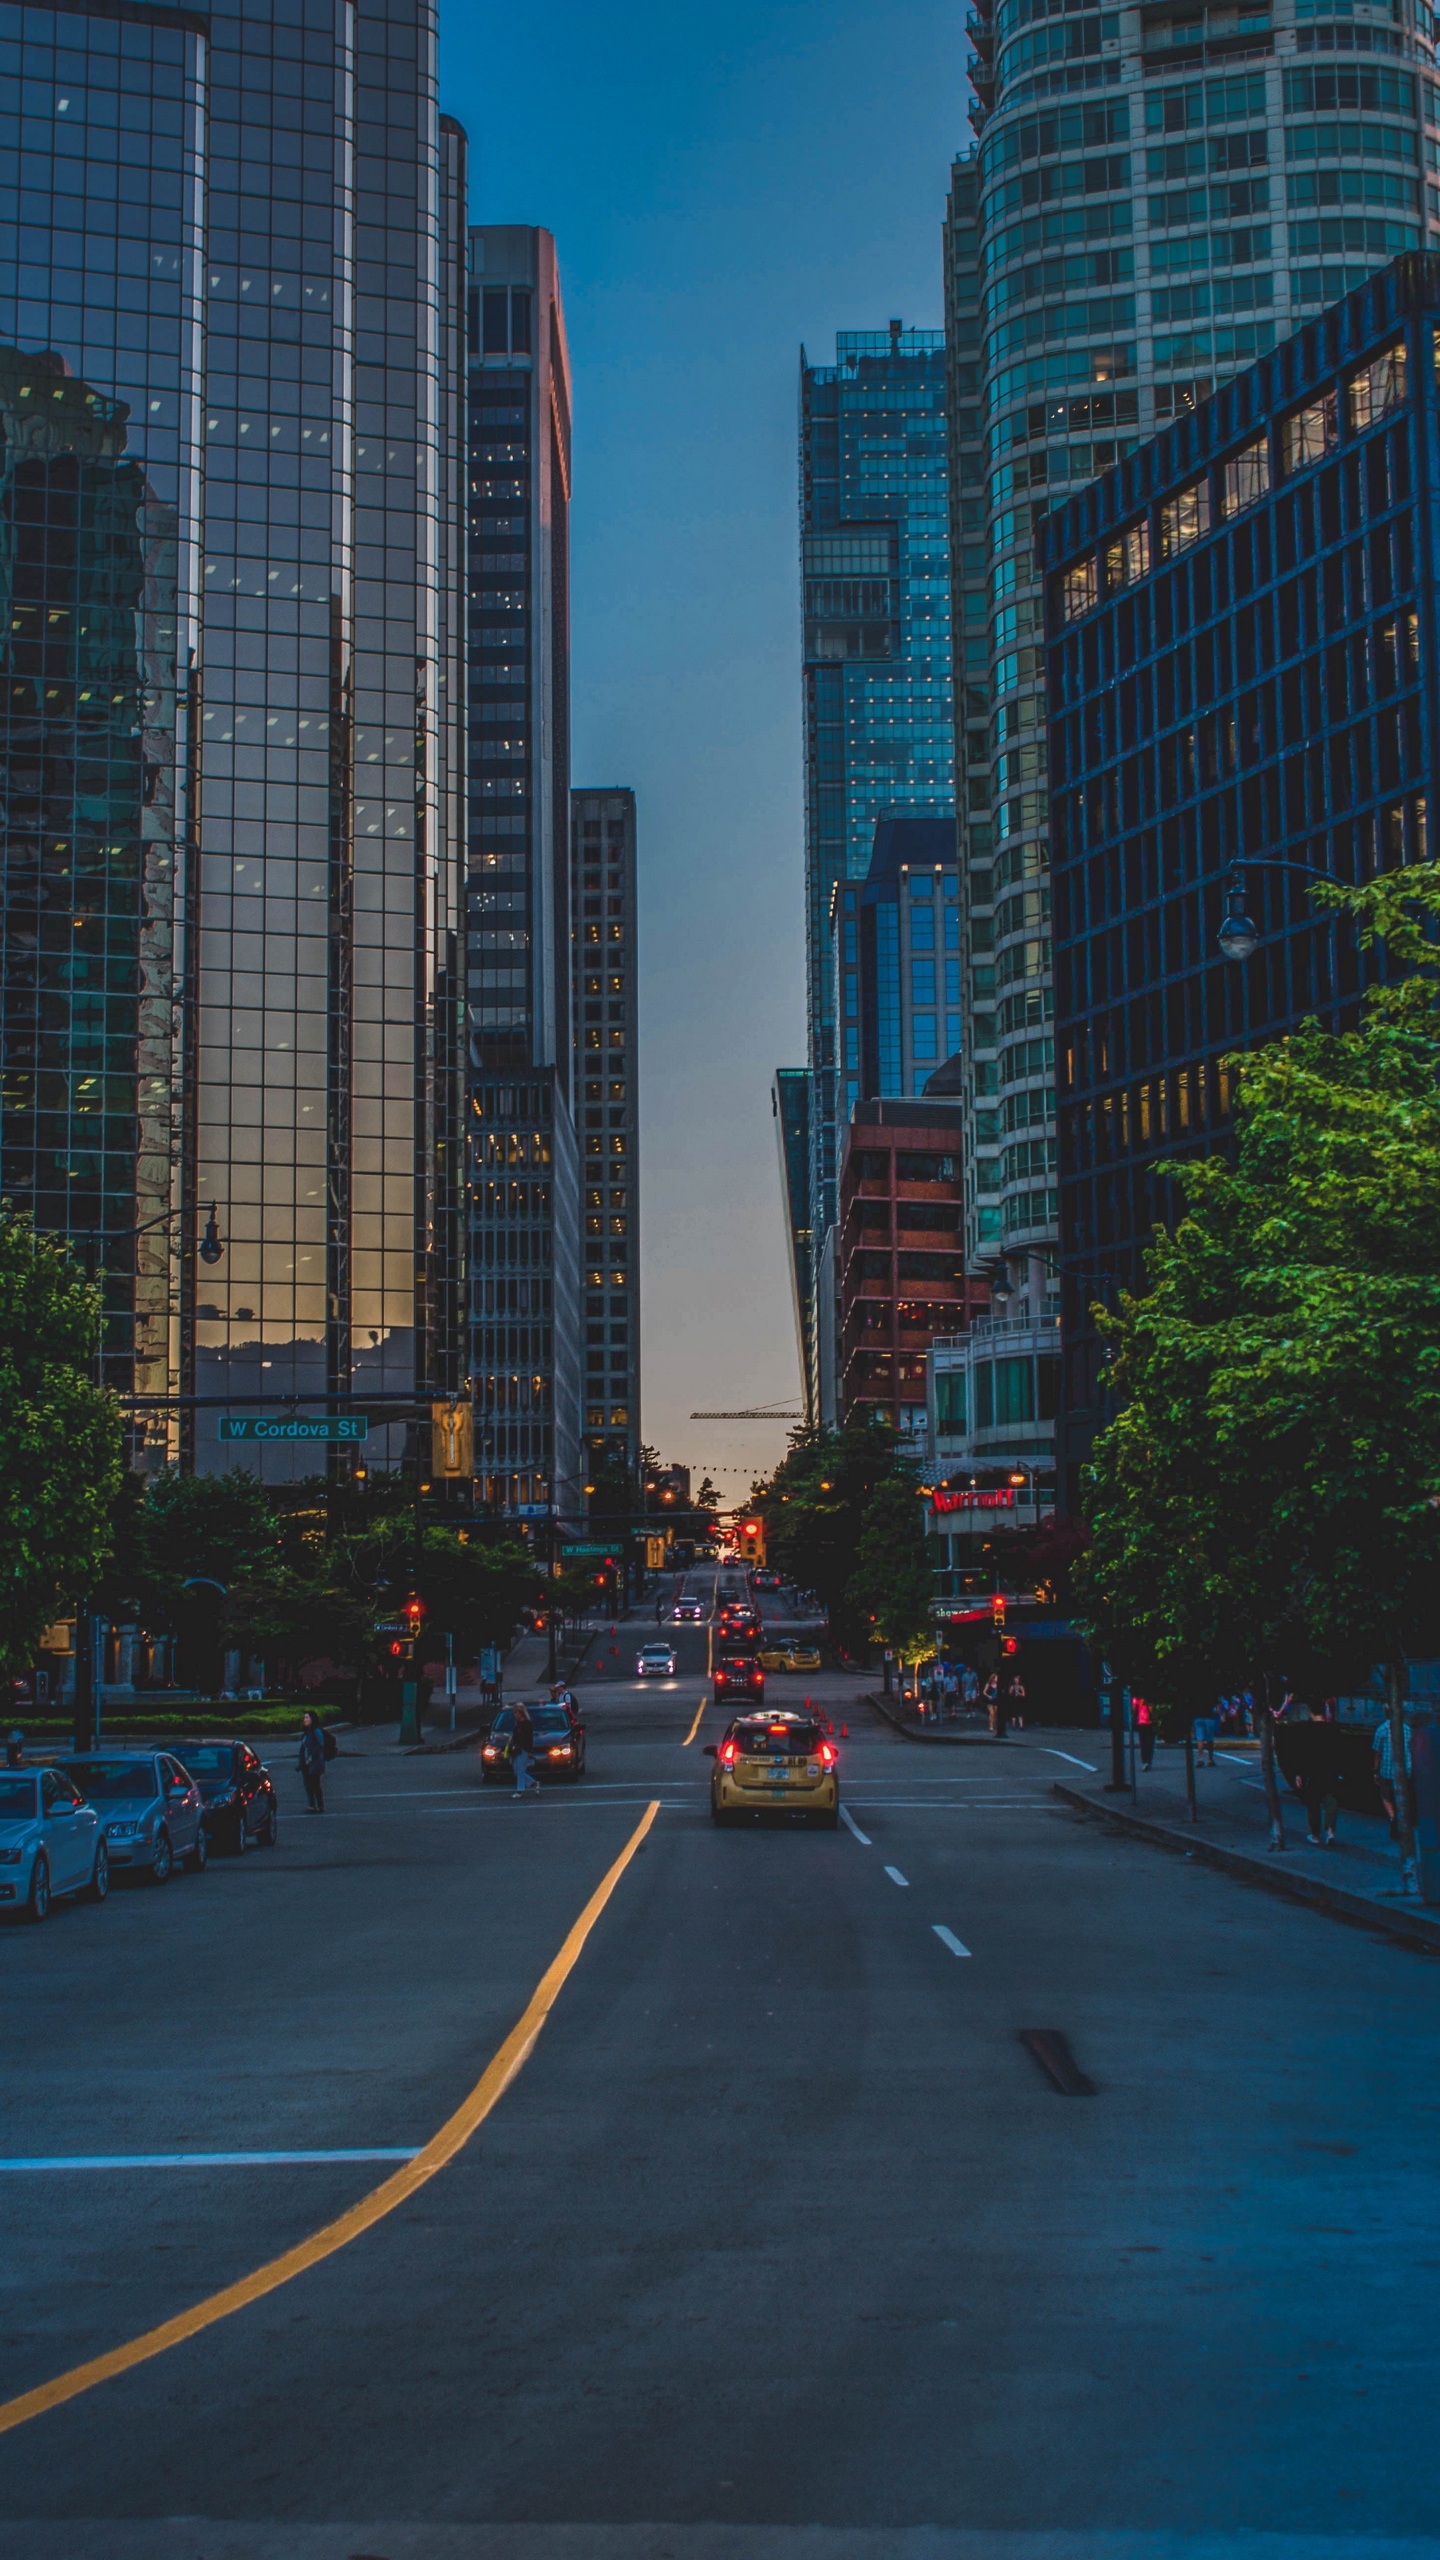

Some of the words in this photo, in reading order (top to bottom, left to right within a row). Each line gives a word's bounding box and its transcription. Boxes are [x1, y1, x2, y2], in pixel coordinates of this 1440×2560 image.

[229, 1421, 247, 1436] W
[254, 1421, 329, 1437] Cordova
[337, 1421, 358, 1437] St
[928, 1487, 1013, 1515] Marriott
[575, 1545, 608, 1554] Hastings
[610, 1545, 619, 1553] St
